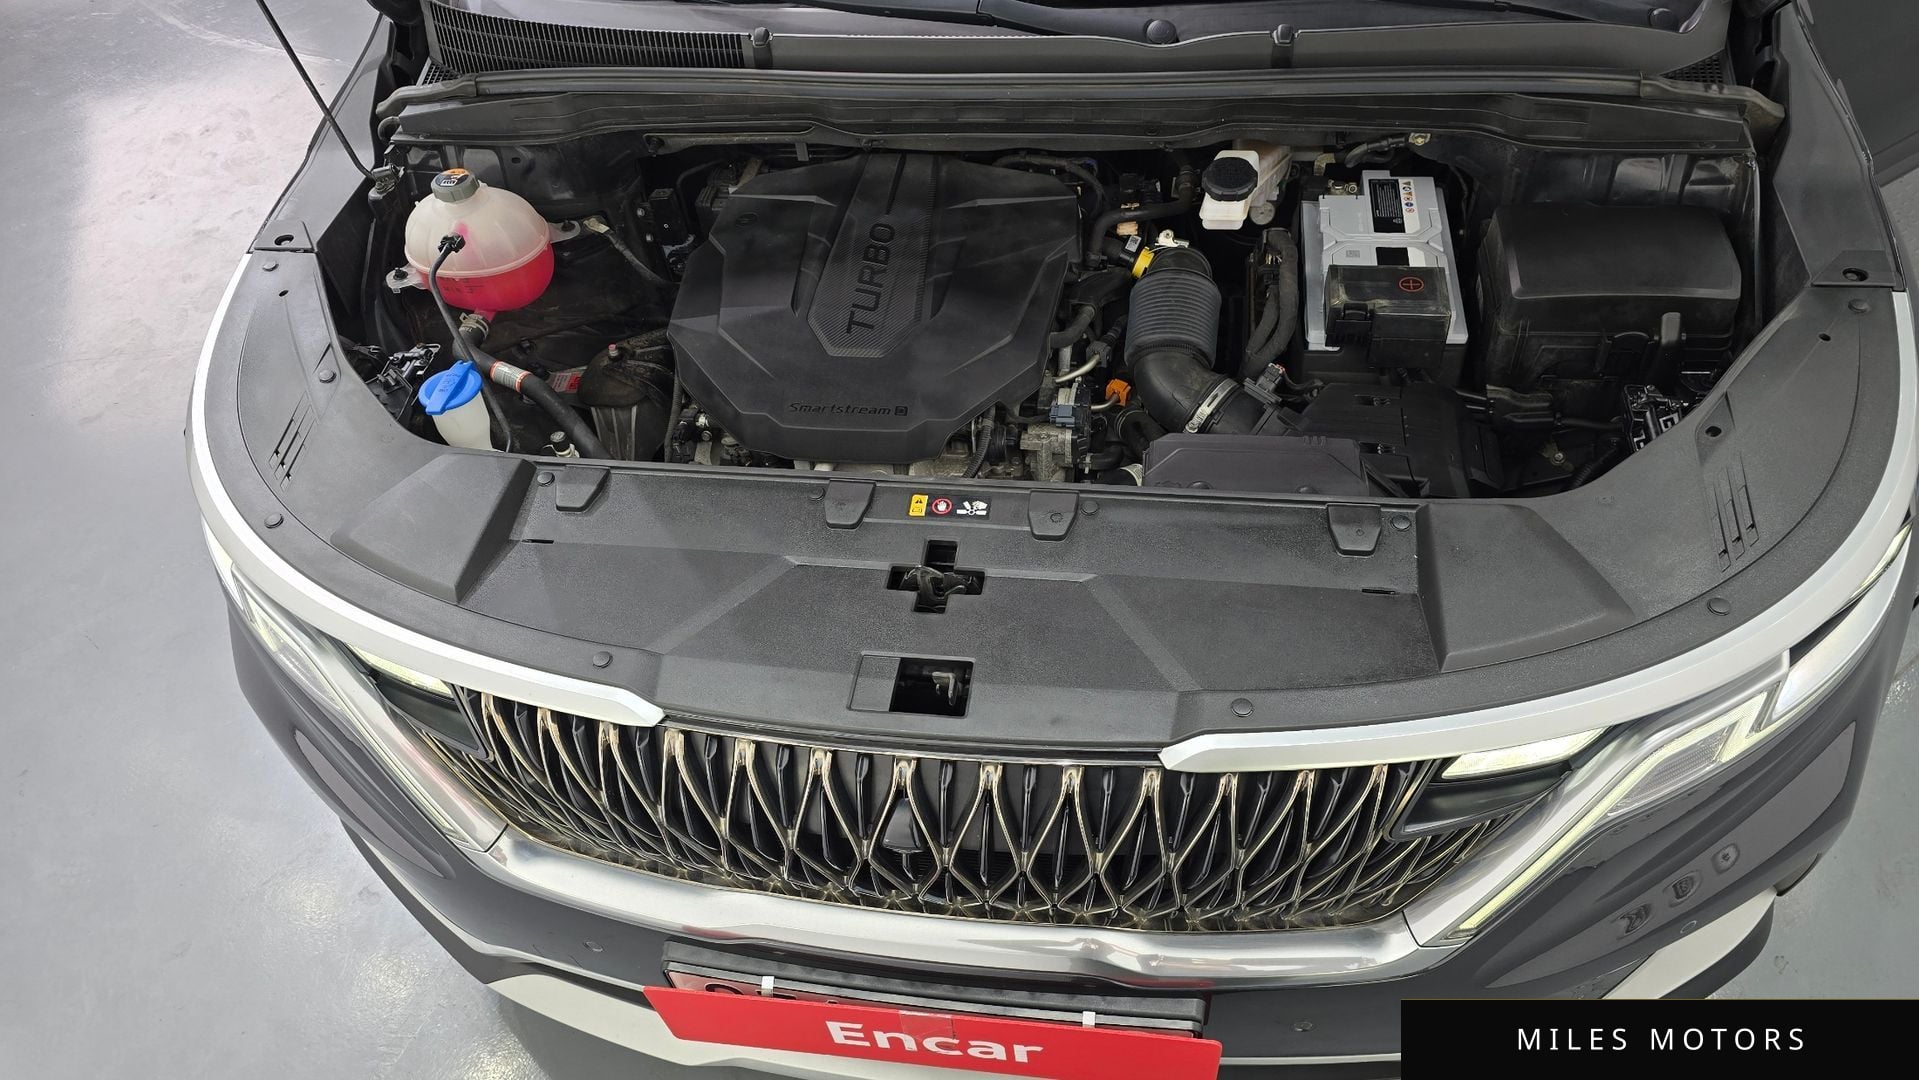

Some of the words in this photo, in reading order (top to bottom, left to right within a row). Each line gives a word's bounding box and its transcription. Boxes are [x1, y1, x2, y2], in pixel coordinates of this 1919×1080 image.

[847, 222, 896, 334] TURBO
[789, 402, 892, 416] Smartstream
[825, 1020, 1043, 1064] Encar
